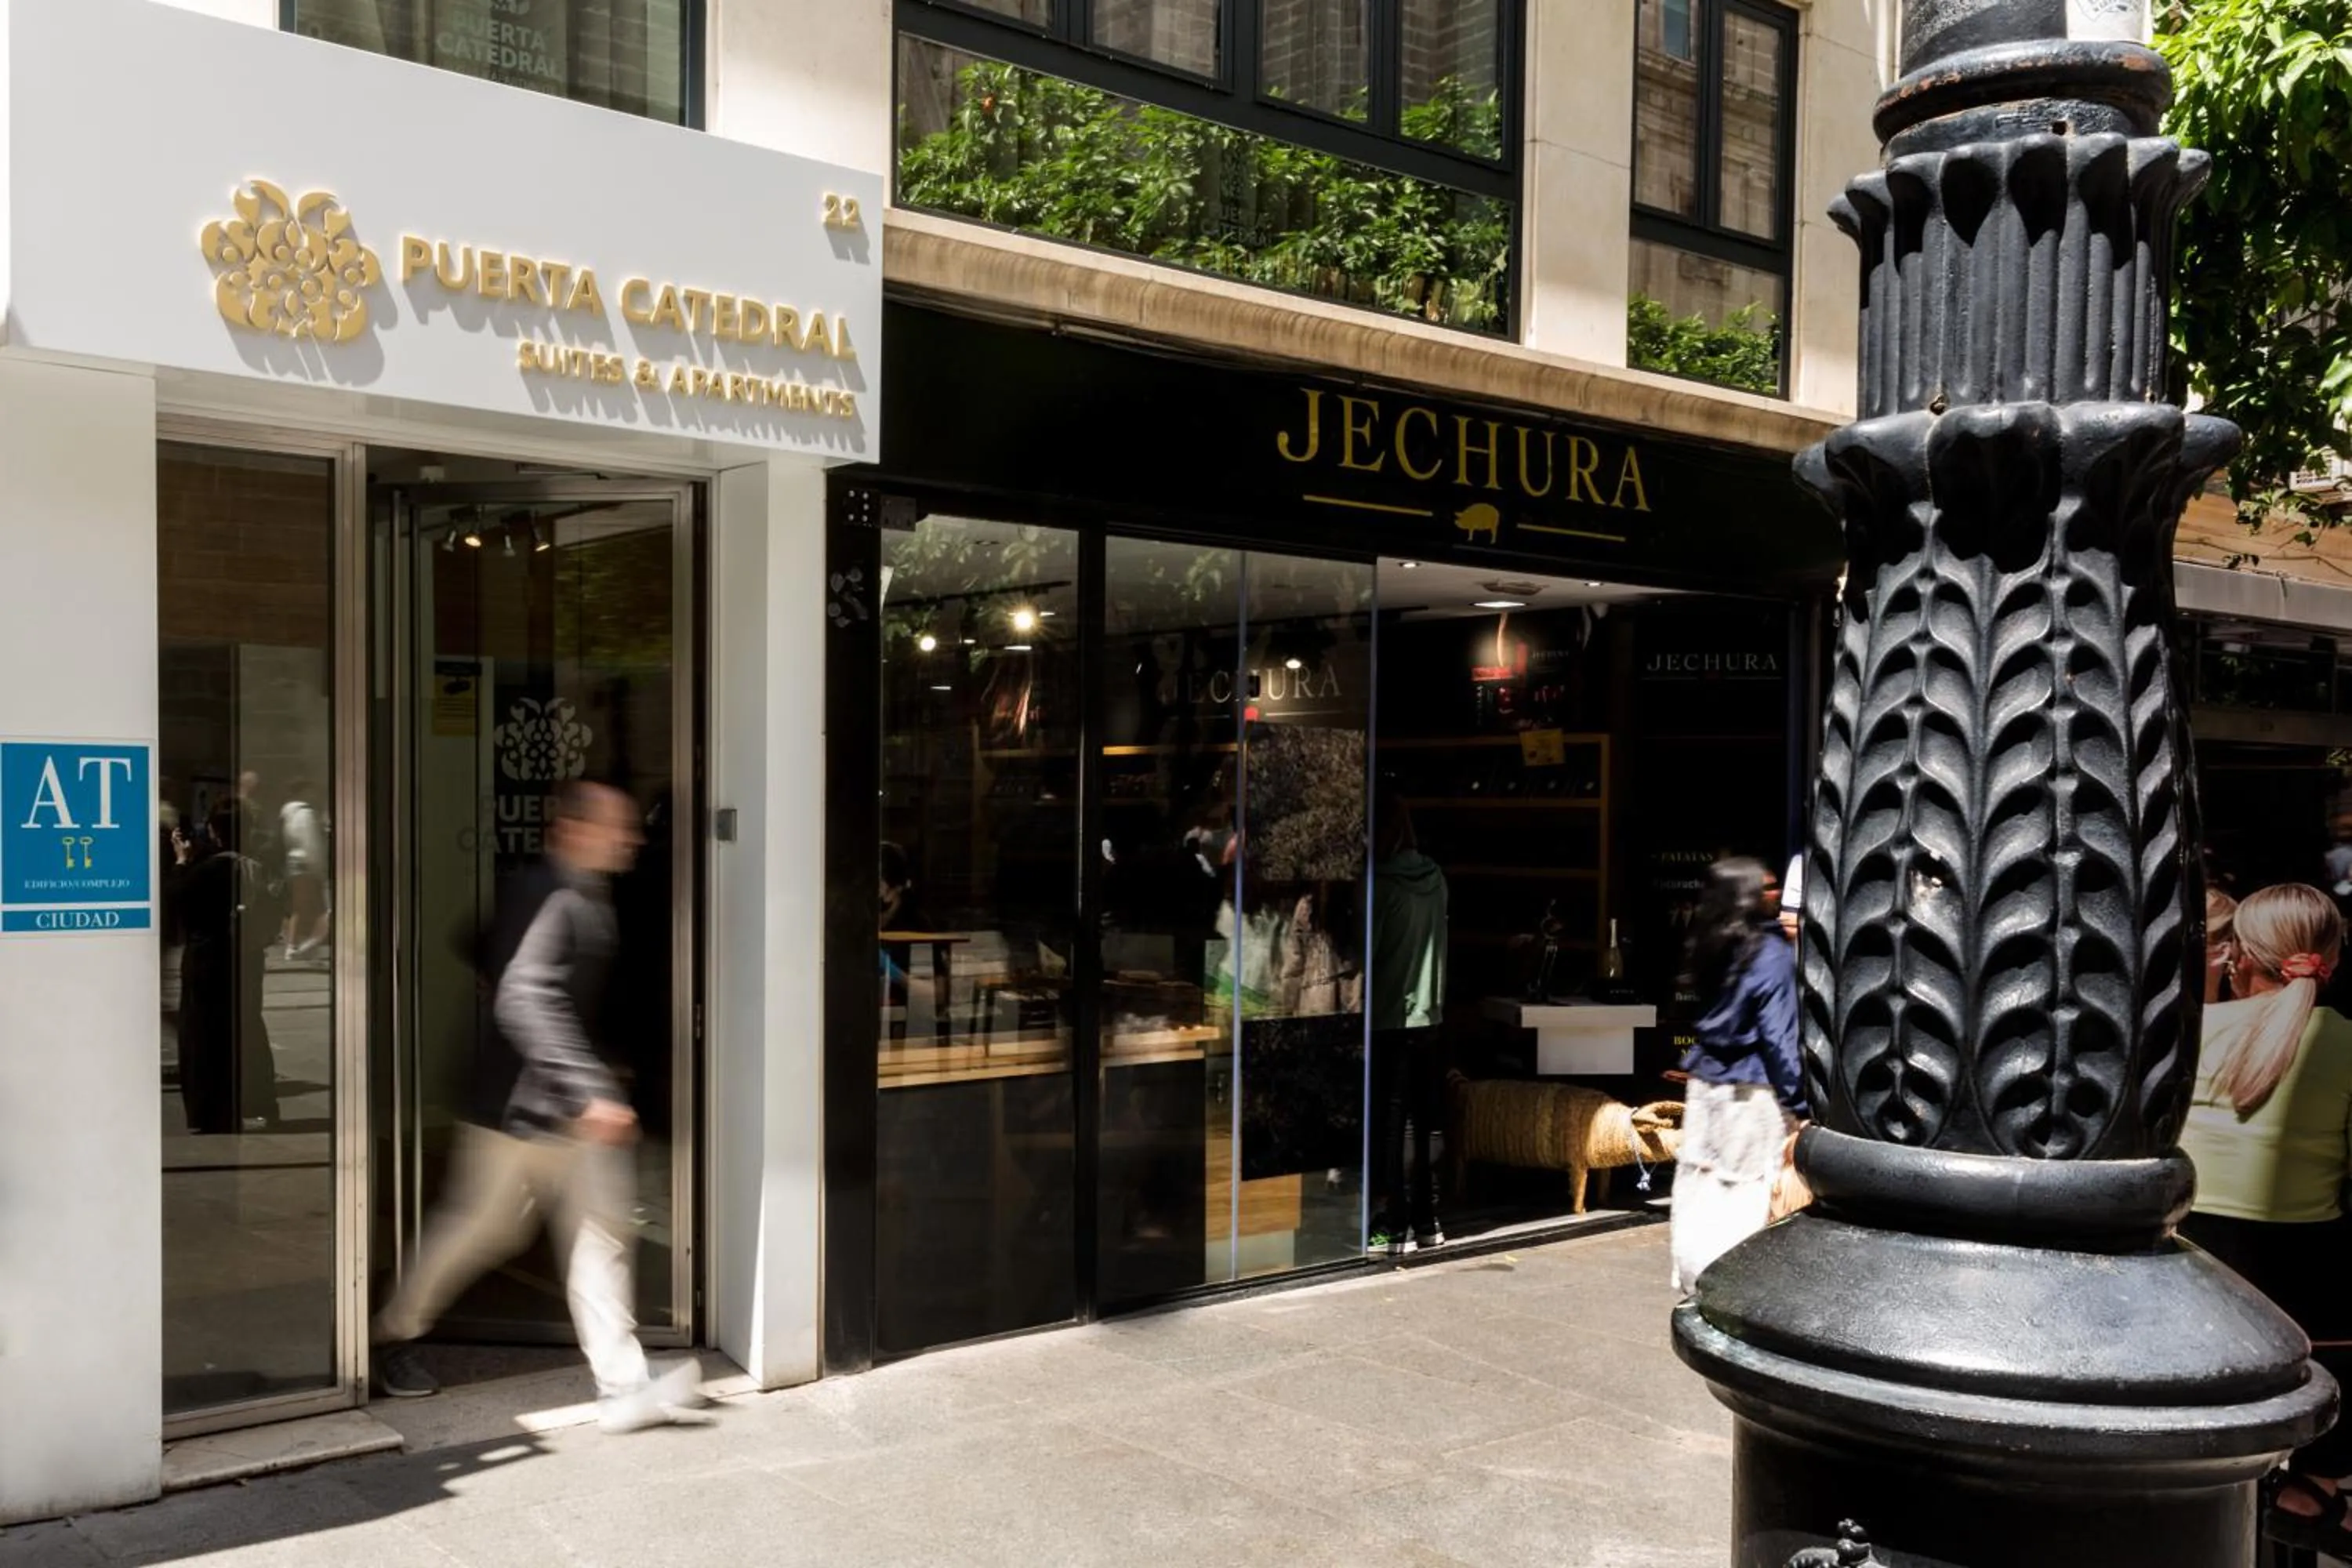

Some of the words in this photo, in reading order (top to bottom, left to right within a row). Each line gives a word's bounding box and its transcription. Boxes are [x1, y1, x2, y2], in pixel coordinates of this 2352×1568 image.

[452, 10, 547, 51] PUERTA
[436, 32, 565, 79] CATEDRAL
[822, 193, 860, 227] 22
[399, 234, 604, 316] PUERTA
[619, 277, 856, 360] CATEDRAL
[517, 339, 625, 384] SUITES
[633, 358, 660, 390] &
[670, 366, 855, 417] APARTMENTS
[1276, 387, 1653, 513] JECHURA
[1646, 652, 1778, 672] JECHURA
[20, 755, 132, 828] AT
[479, 792, 561, 823] PUER
[457, 826, 543, 855] CATE
[36, 912, 120, 929] CIUDAD
